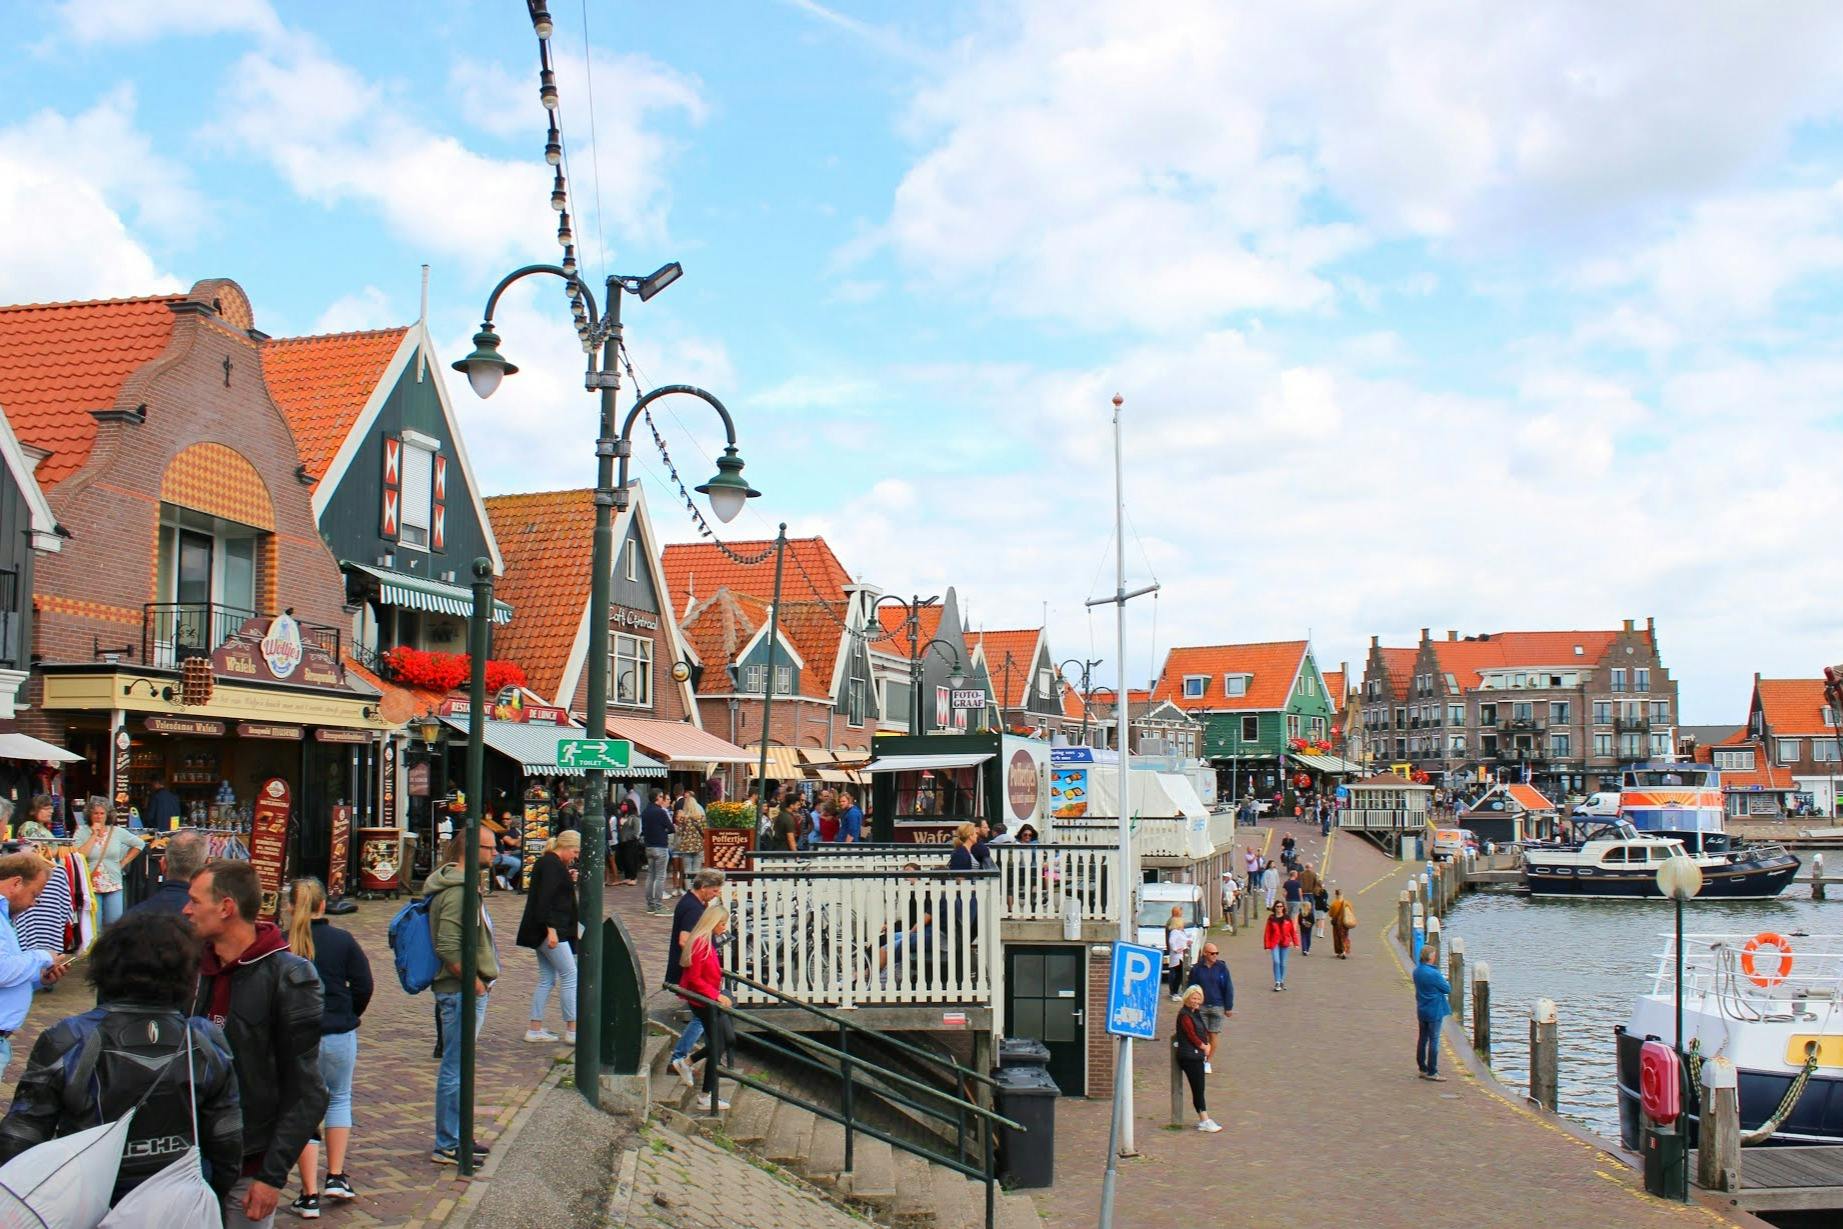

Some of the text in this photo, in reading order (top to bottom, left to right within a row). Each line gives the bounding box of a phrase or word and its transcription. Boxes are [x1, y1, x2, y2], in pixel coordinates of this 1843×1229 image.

[225, 656, 257, 674] Wafels
[953, 691, 982, 699] FOTO-
[953, 699, 983, 707] GRAAF
[712, 835, 748, 844] Poffertjes
[1125, 951, 1151, 996] P
